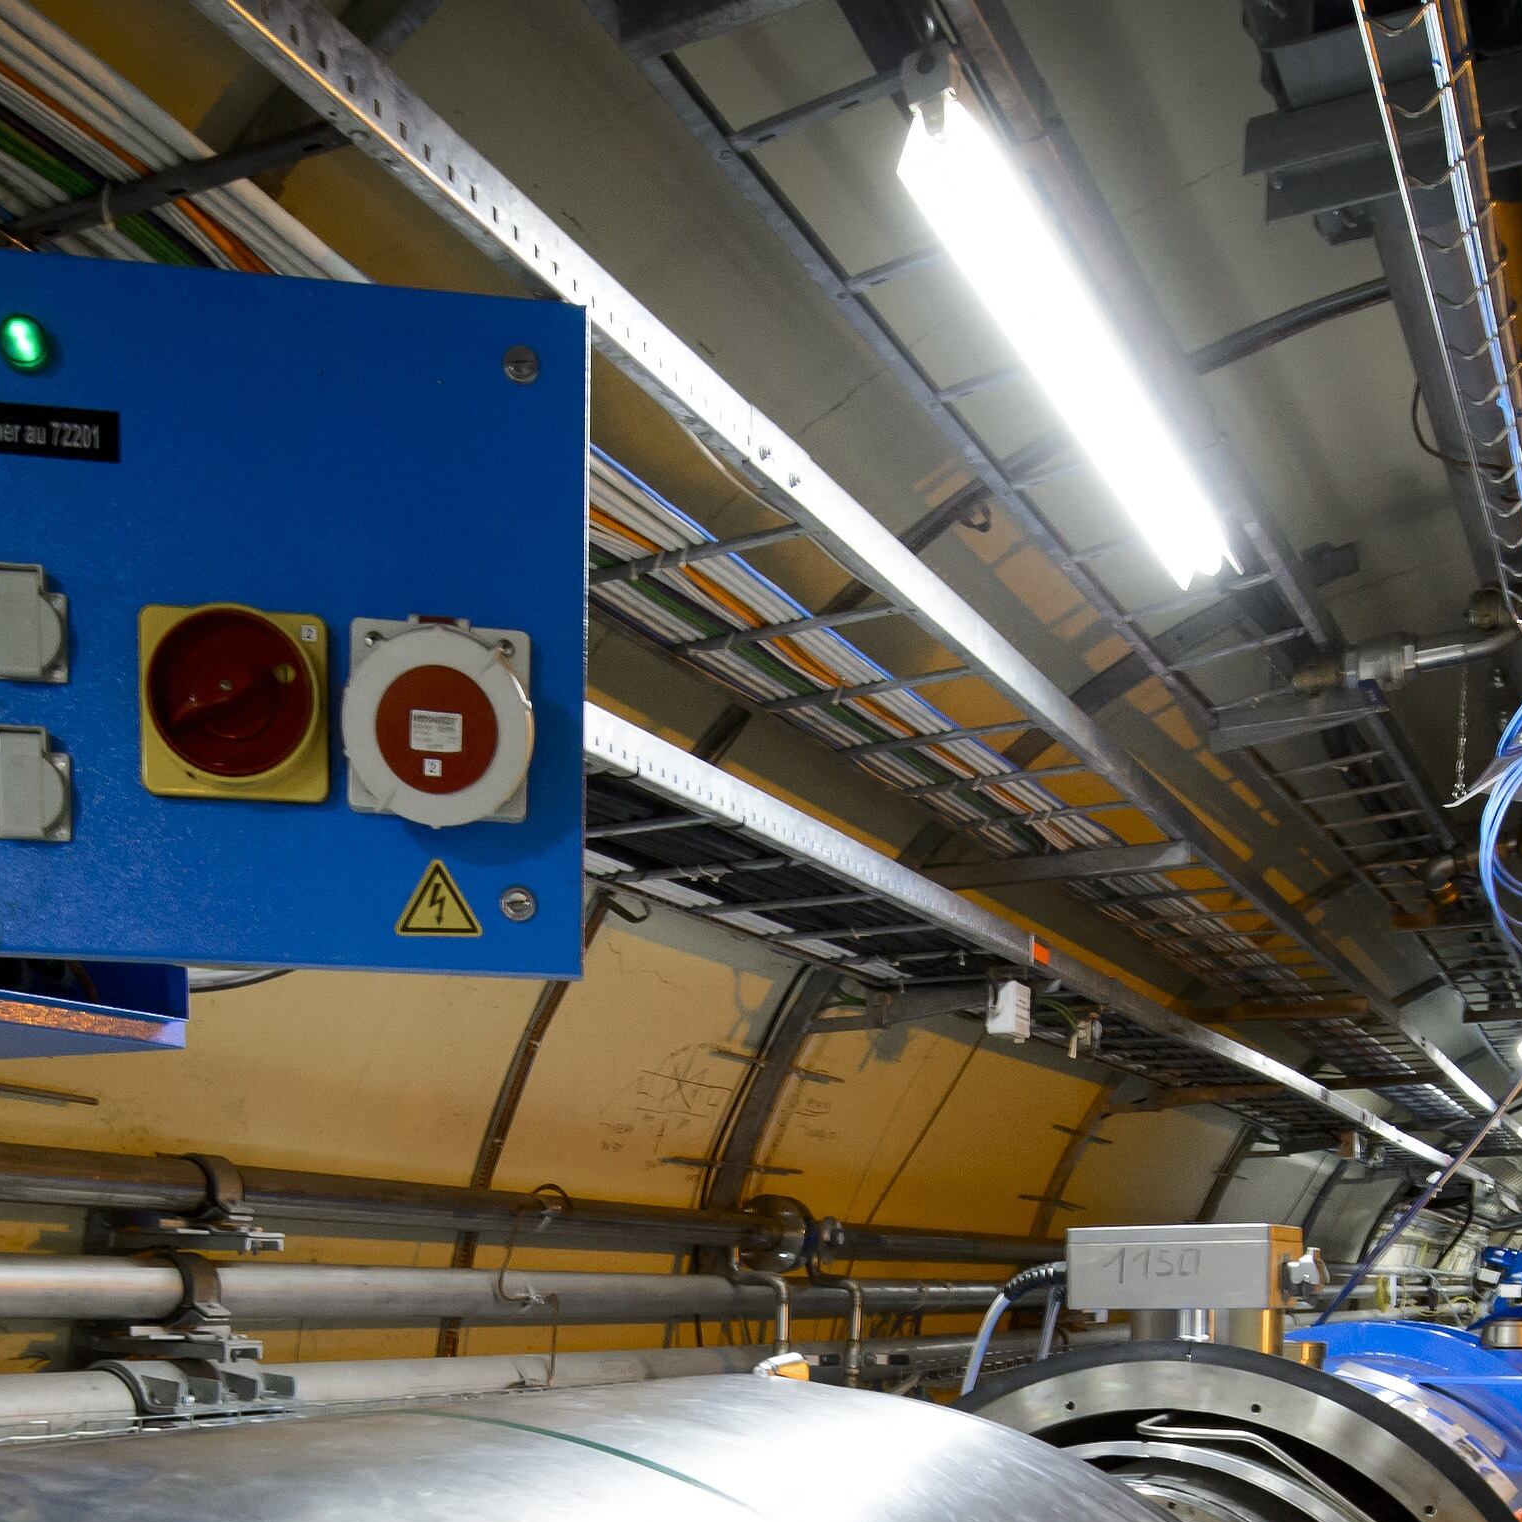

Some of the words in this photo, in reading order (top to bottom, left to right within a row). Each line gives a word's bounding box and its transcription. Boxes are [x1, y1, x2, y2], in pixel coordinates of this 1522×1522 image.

[24, 424, 47, 445] au
[49, 421, 100, 449] 72201
[1102, 1247, 1202, 1285] 1150
